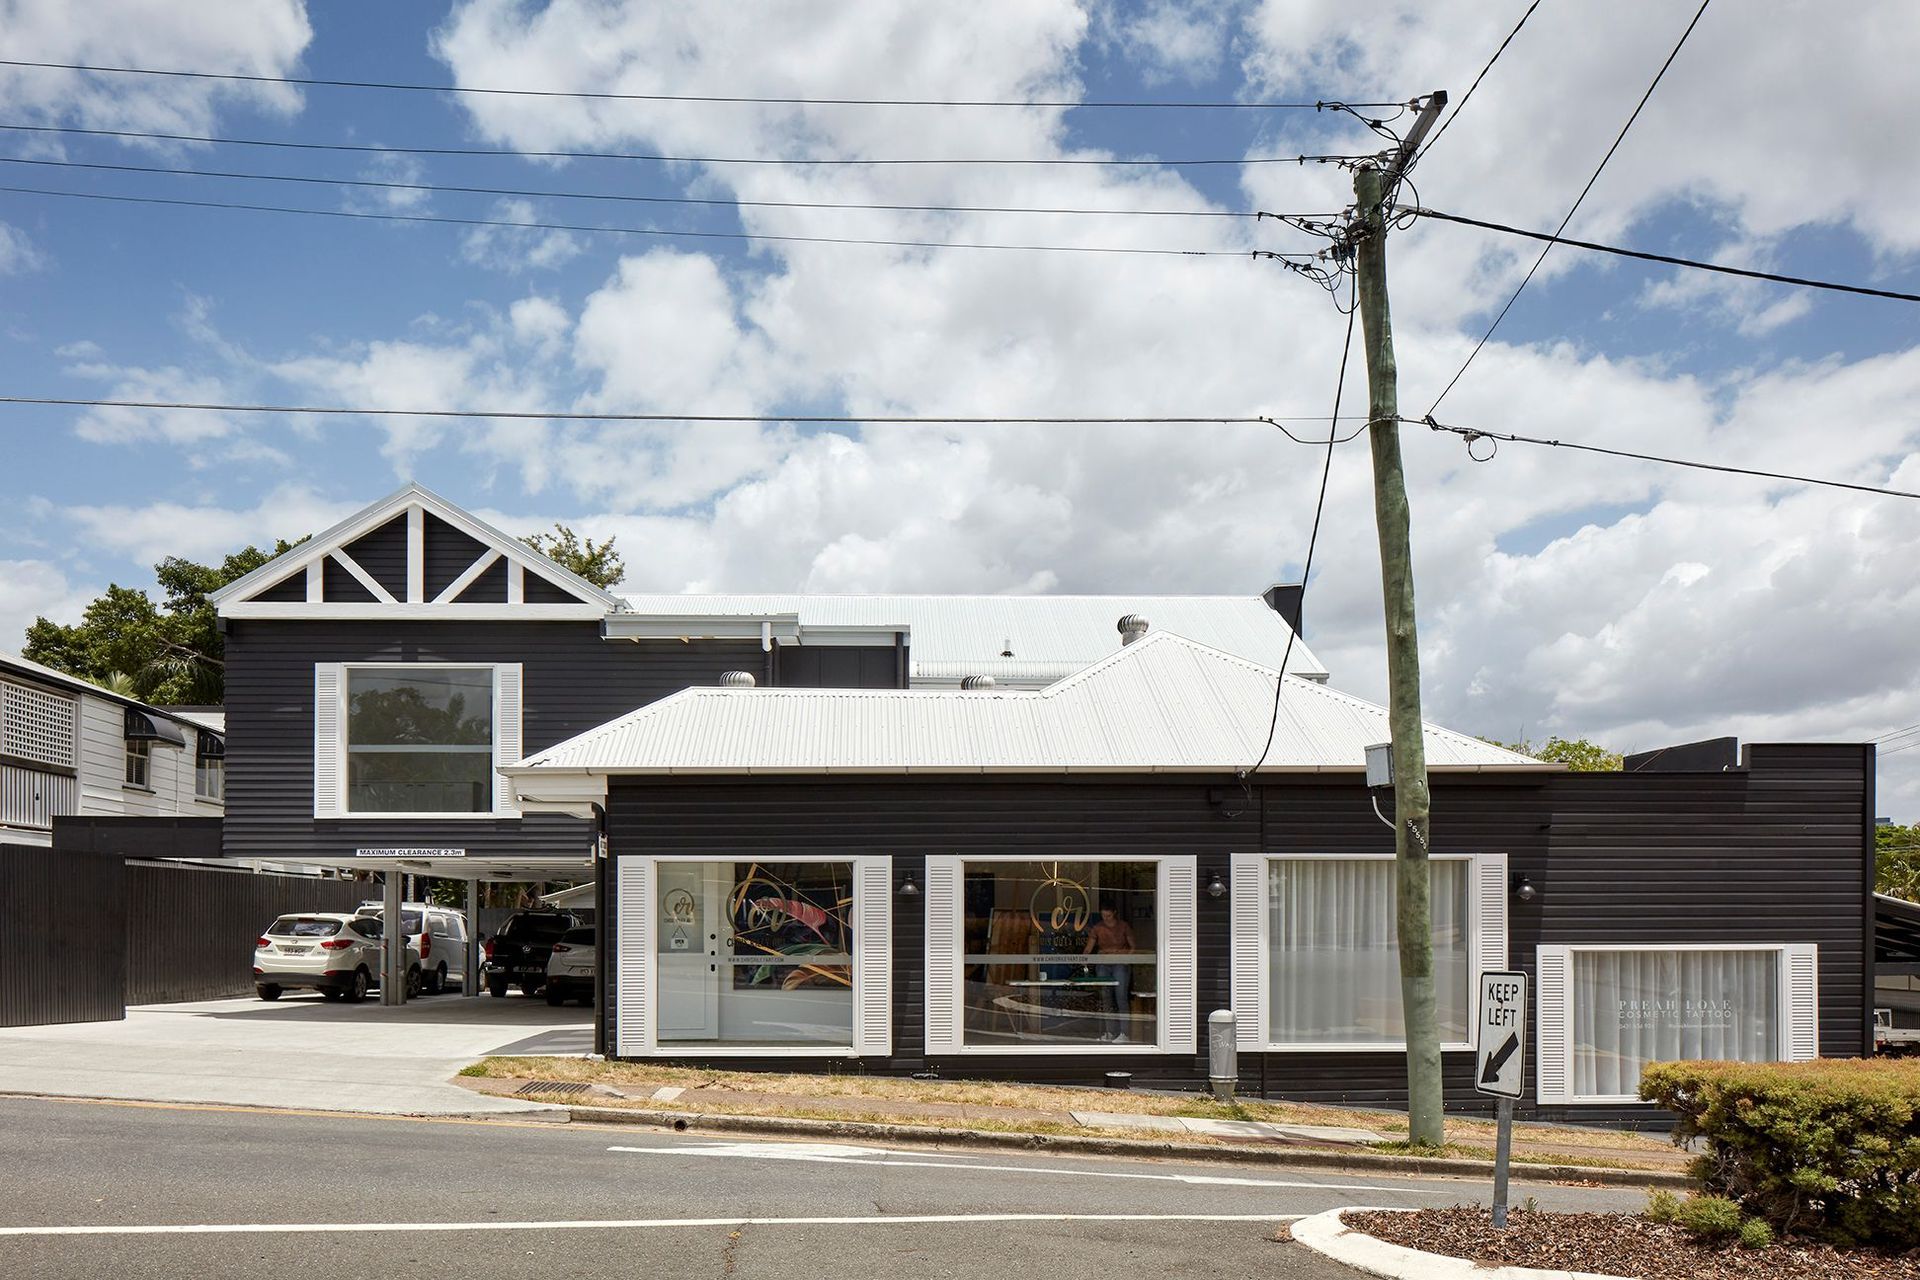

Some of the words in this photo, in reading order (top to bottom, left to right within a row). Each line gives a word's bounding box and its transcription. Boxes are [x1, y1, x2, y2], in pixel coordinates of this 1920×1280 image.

[1488, 983, 1519, 1002] KEEP
[1620, 1000, 1675, 1010] PREAH
[1686, 1000, 1731, 1010] LOVE
[1488, 1008, 1516, 1027] LEFT
[1620, 1010, 1679, 1018] COSMETIC
[1687, 1010, 1732, 1018] TATTOO
